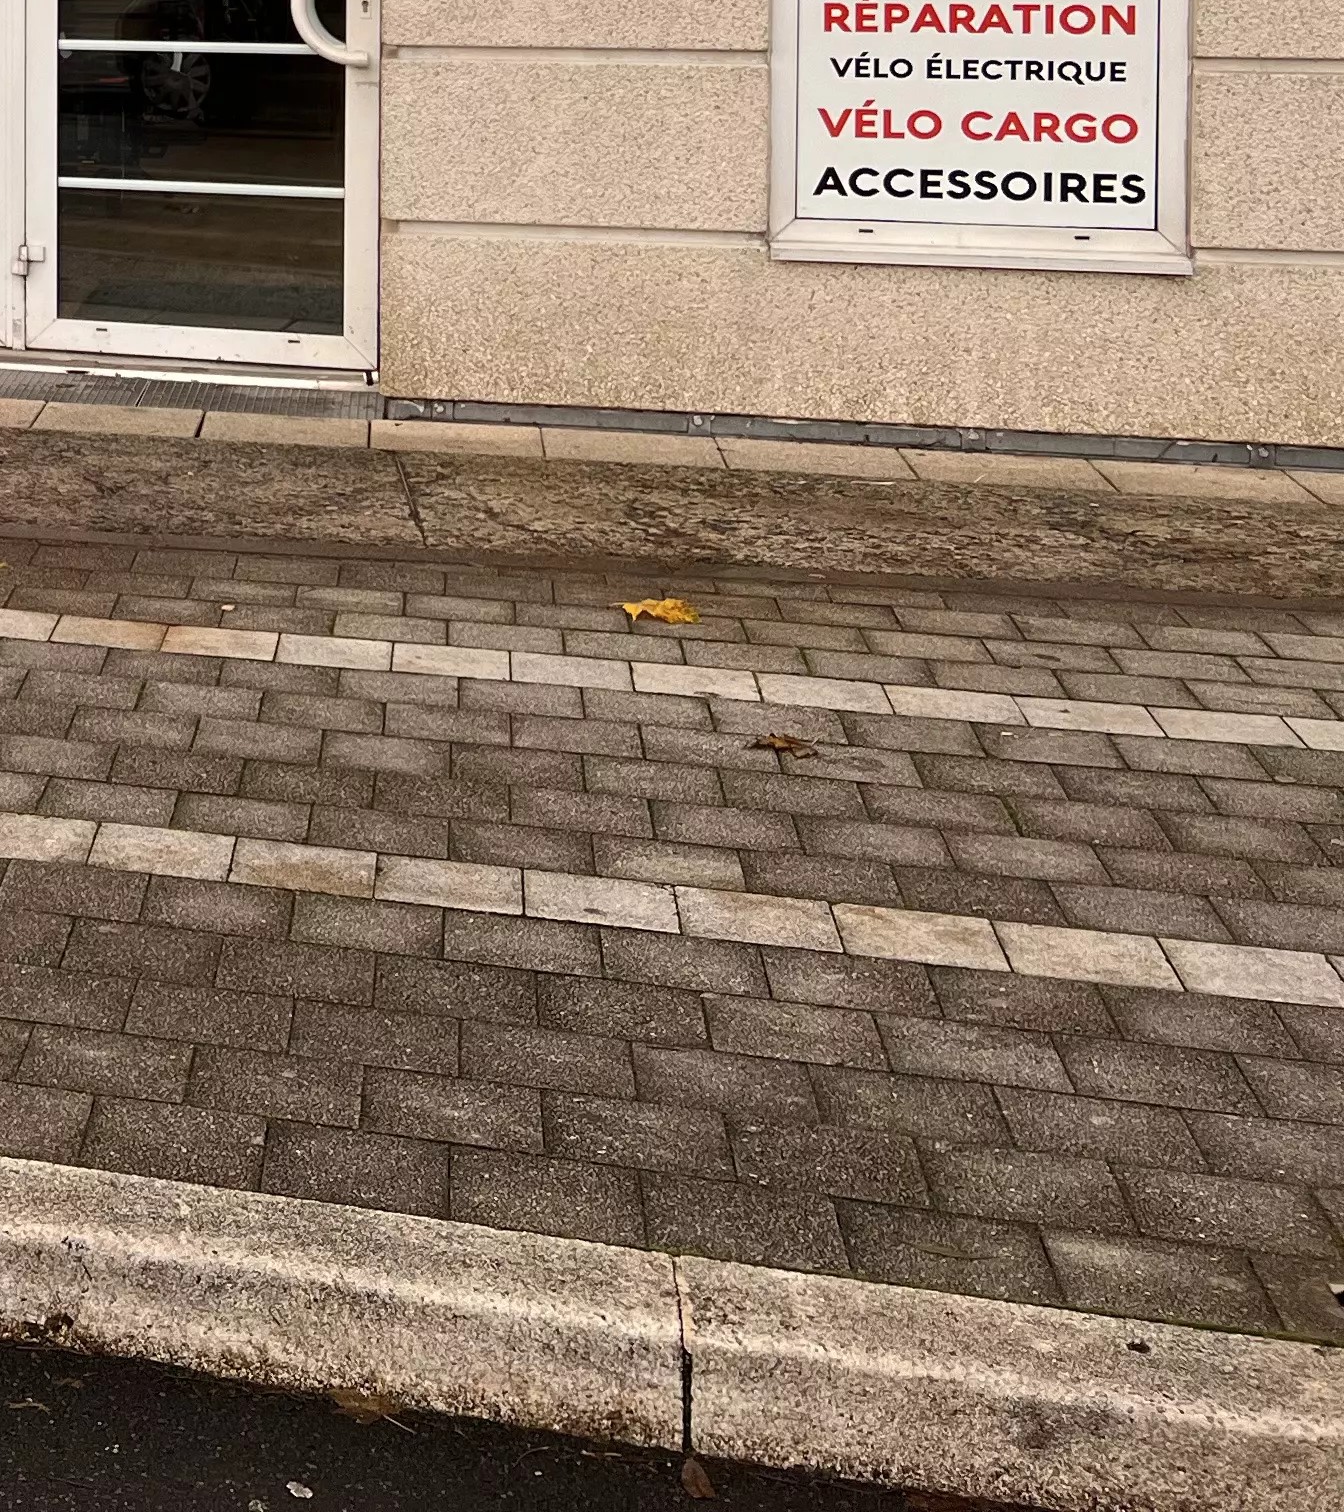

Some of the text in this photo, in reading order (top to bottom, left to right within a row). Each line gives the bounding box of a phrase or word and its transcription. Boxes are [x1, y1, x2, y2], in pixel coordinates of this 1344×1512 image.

[830, 52, 1127, 85] VÉLO ÉLECTRIQUE
[817, 99, 1139, 144] VÉLO CARGO
[812, 167, 1146, 204] ACCESSOIRES
